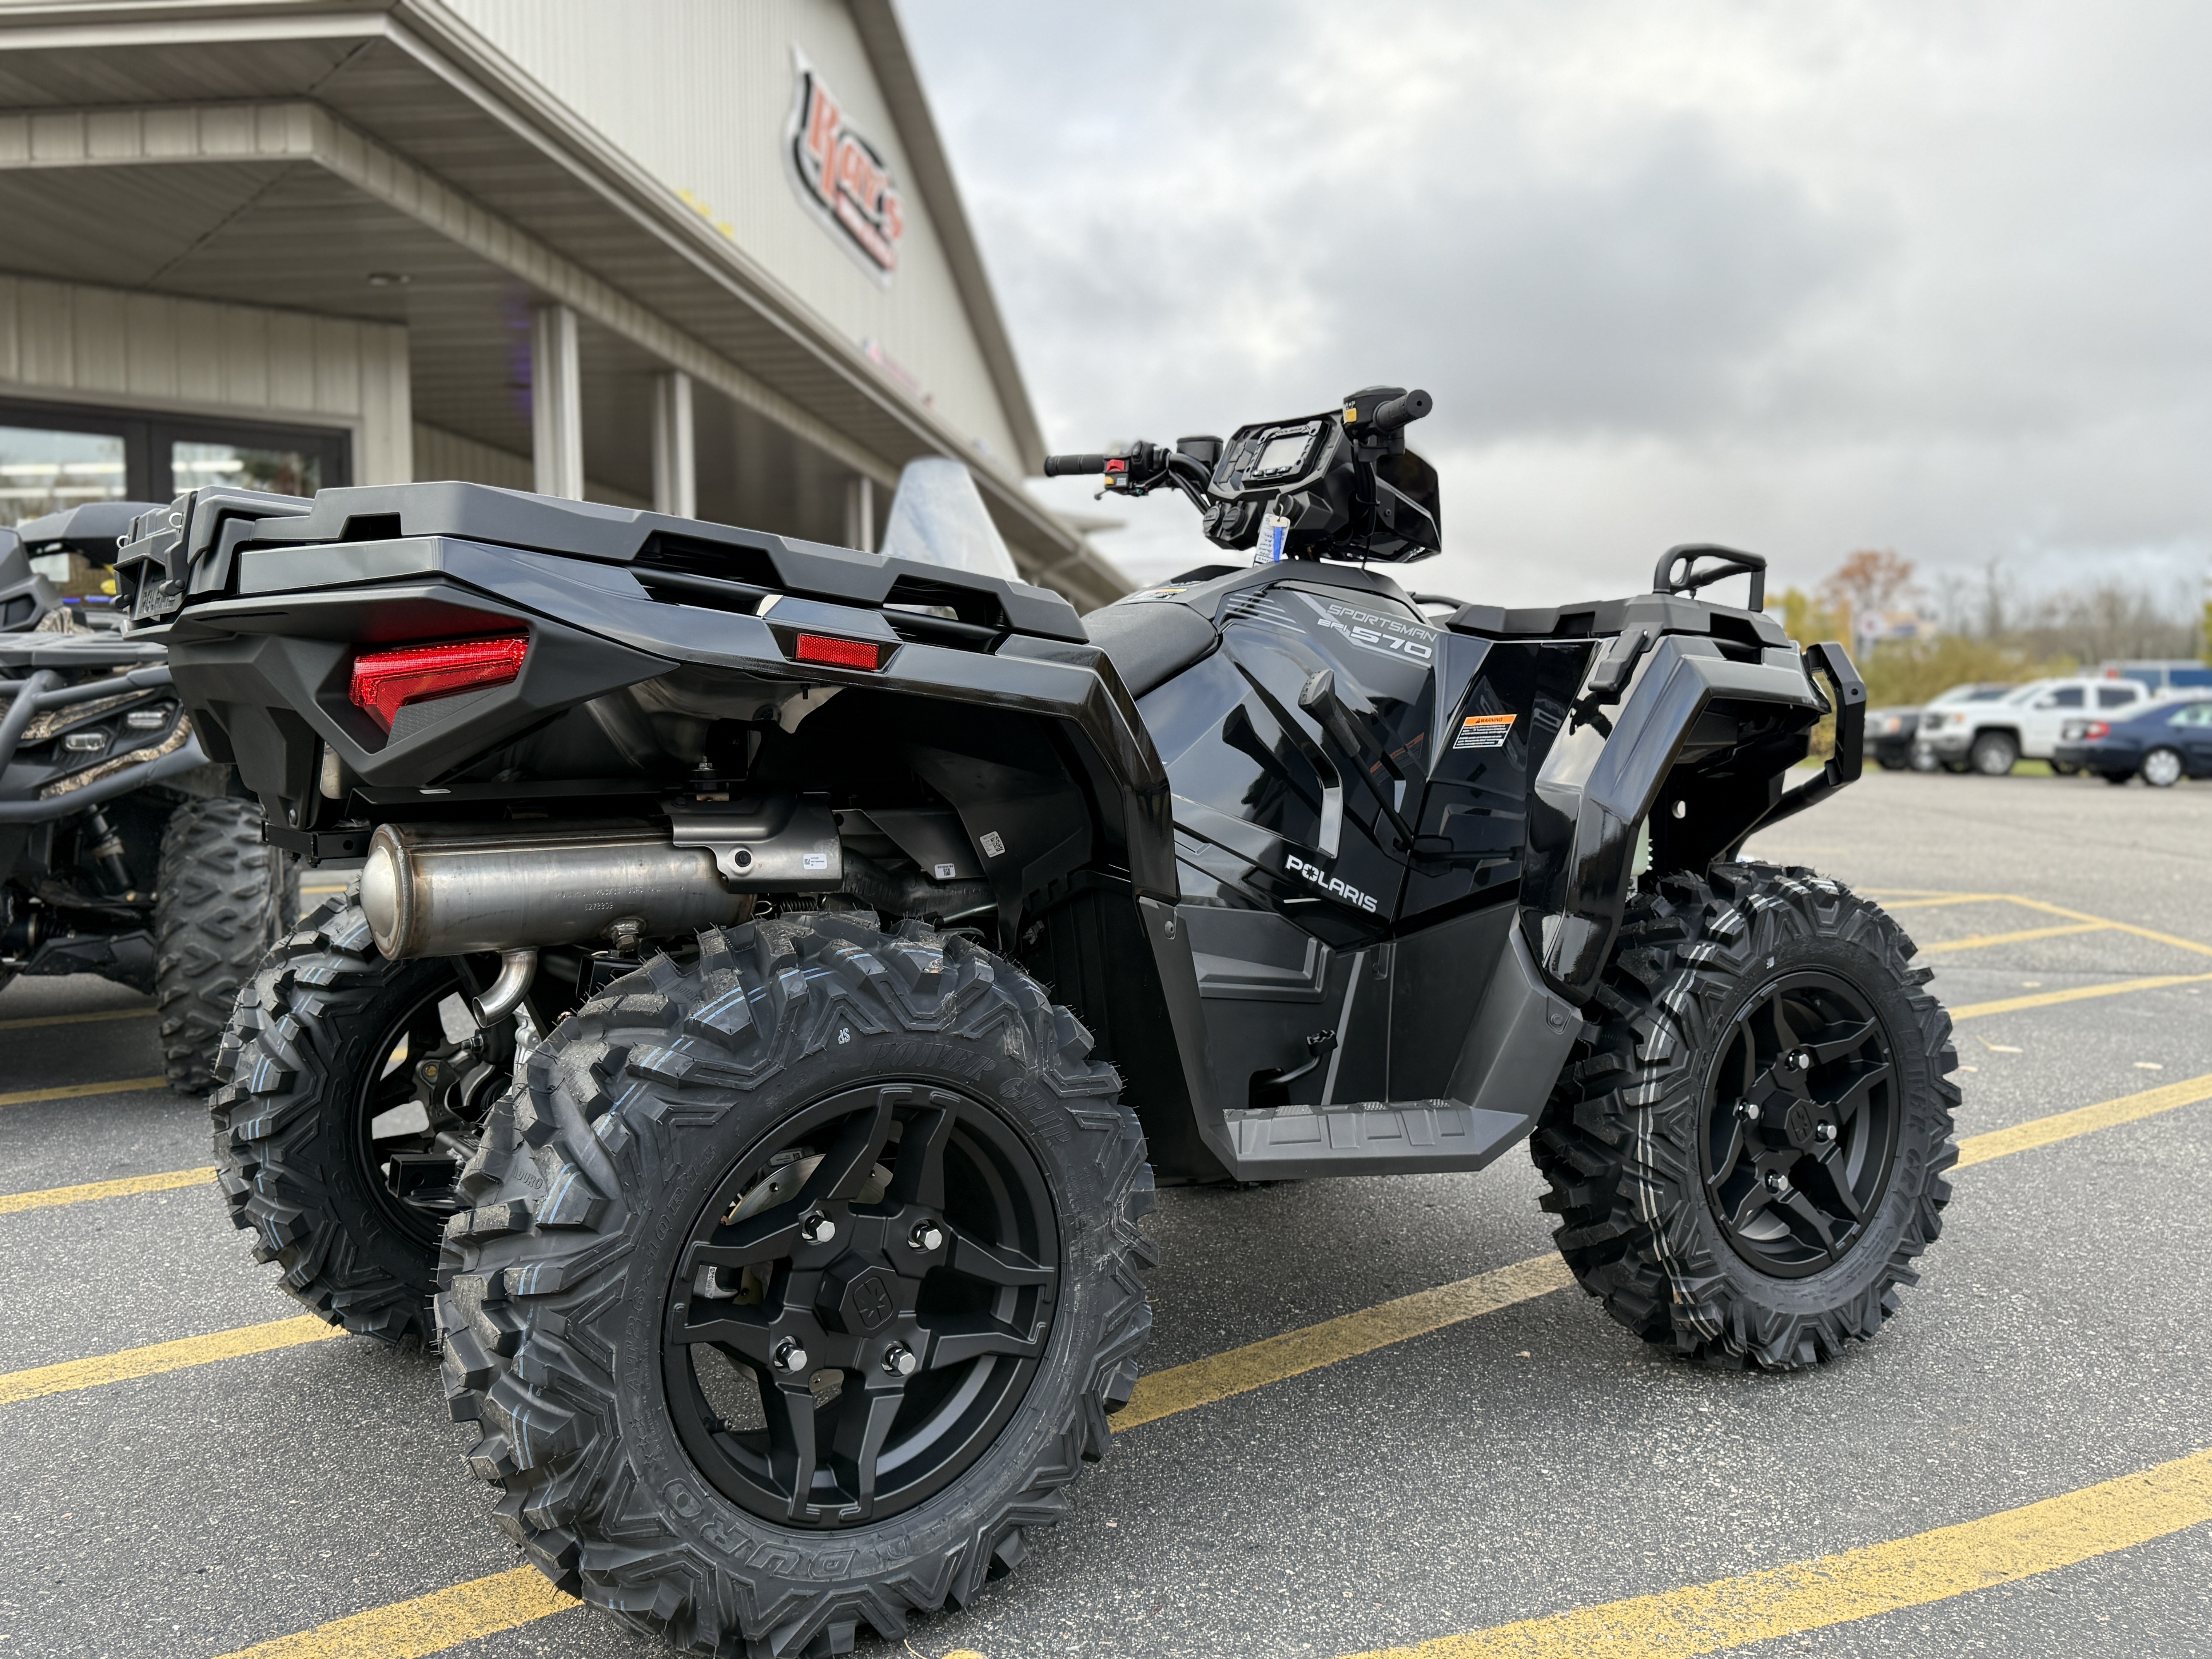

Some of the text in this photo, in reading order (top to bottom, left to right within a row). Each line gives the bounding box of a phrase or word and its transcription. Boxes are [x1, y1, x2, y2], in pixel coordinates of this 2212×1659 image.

[1317, 618, 1432, 659] EFI 570
[1326, 604, 1437, 642] SPORTSMAN
[1285, 854, 1378, 913] POLARIS
[860, 1041, 1071, 1142] POWER GRIP
[517, 1168, 543, 1190] DURO
[1891, 1148, 1921, 1227] GRIP
[661, 1477, 857, 1581] DURO
